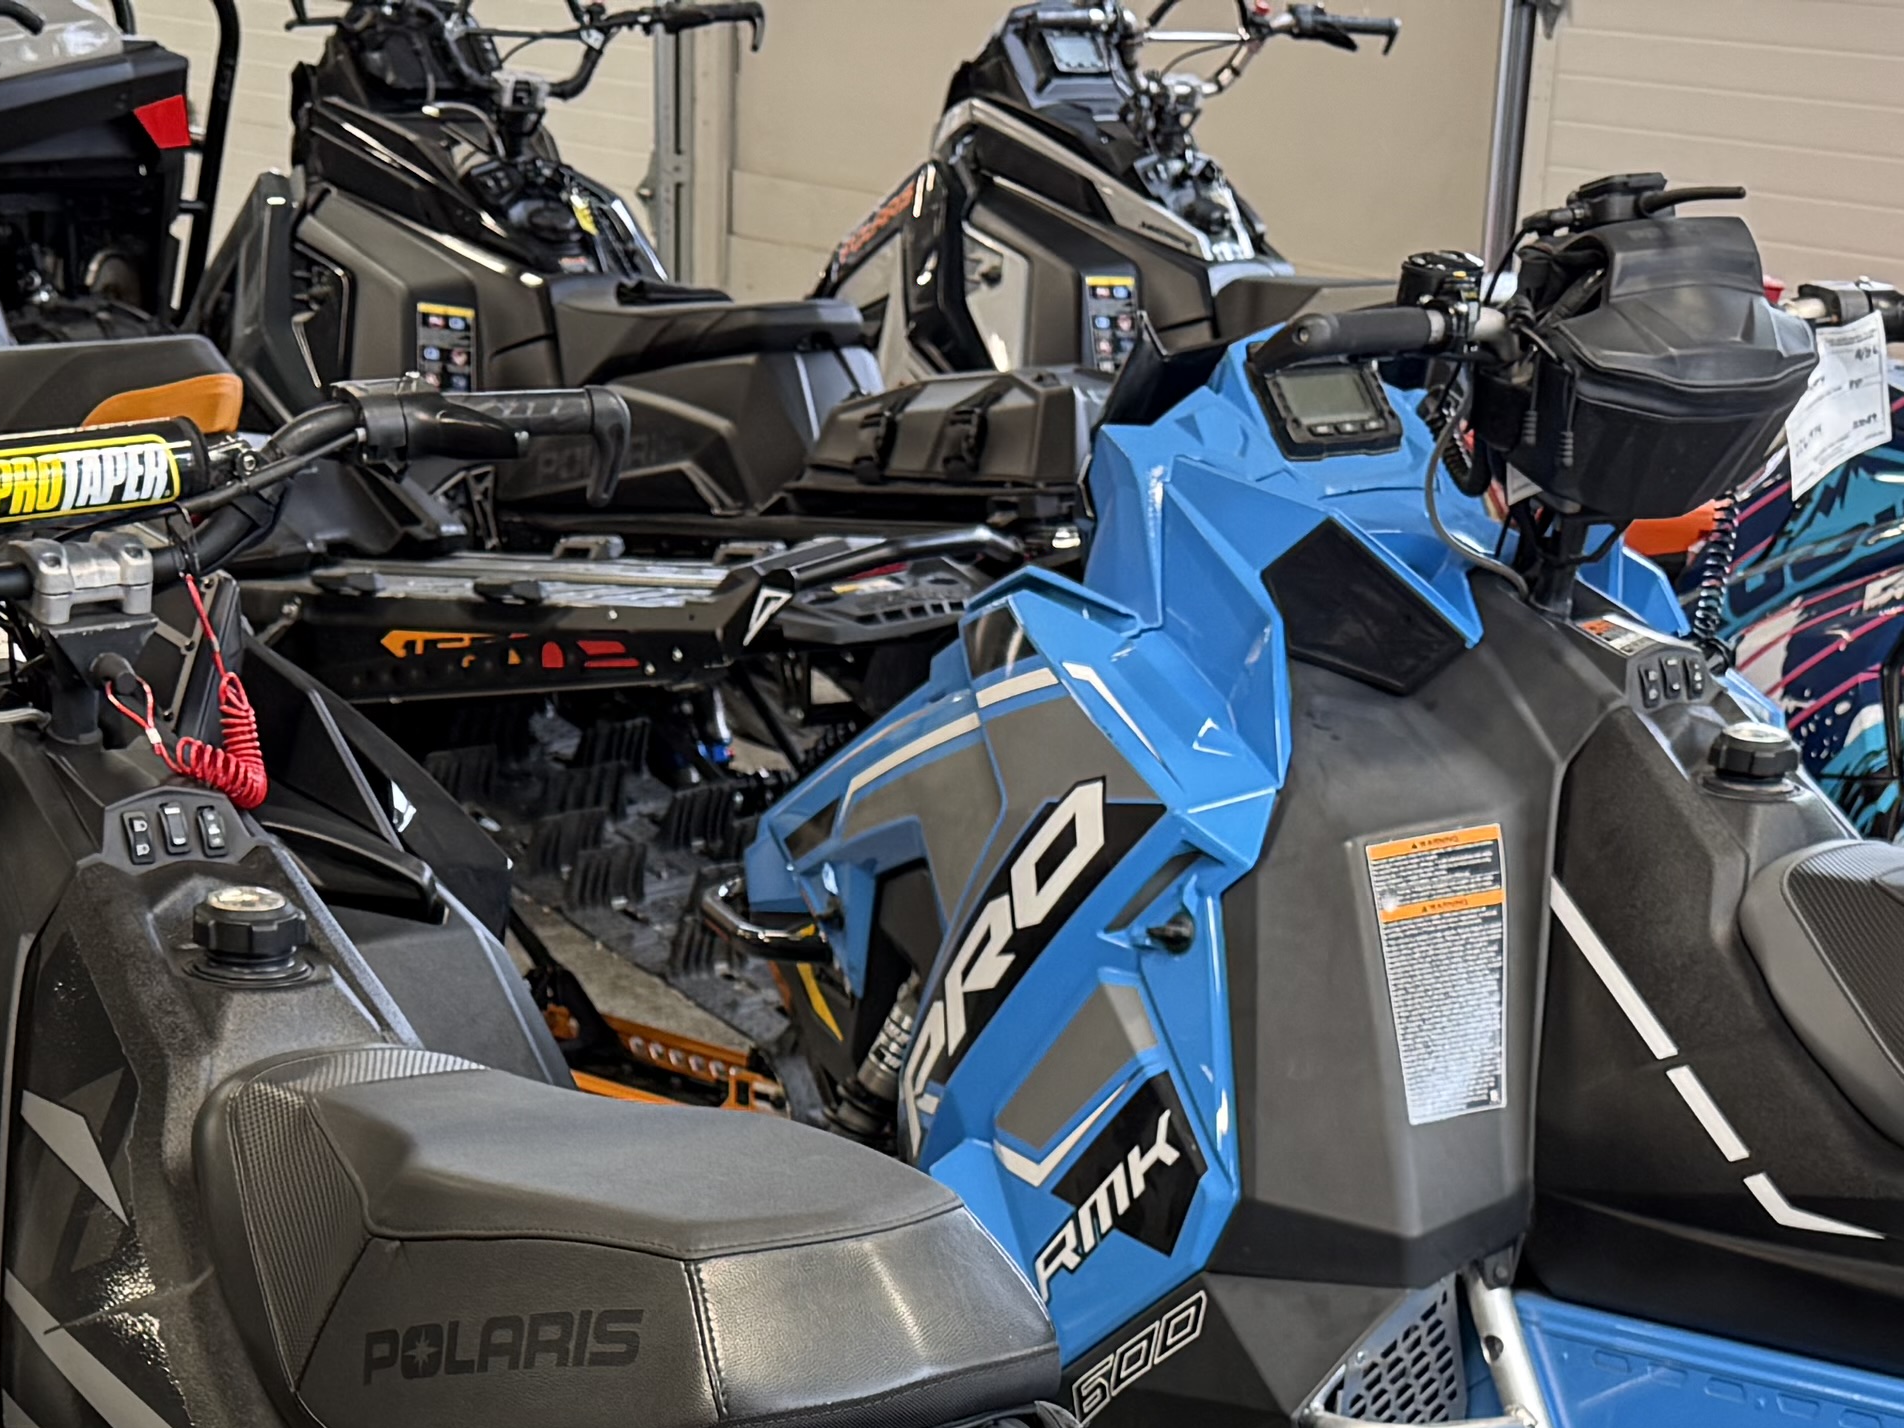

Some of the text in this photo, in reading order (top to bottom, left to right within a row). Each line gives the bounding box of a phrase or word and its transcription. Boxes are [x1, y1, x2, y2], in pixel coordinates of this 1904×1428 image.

[901, 780, 1105, 1159] PRO
[1034, 1109, 1181, 1303] RMK
[363, 1309, 645, 1386] POLARIS
